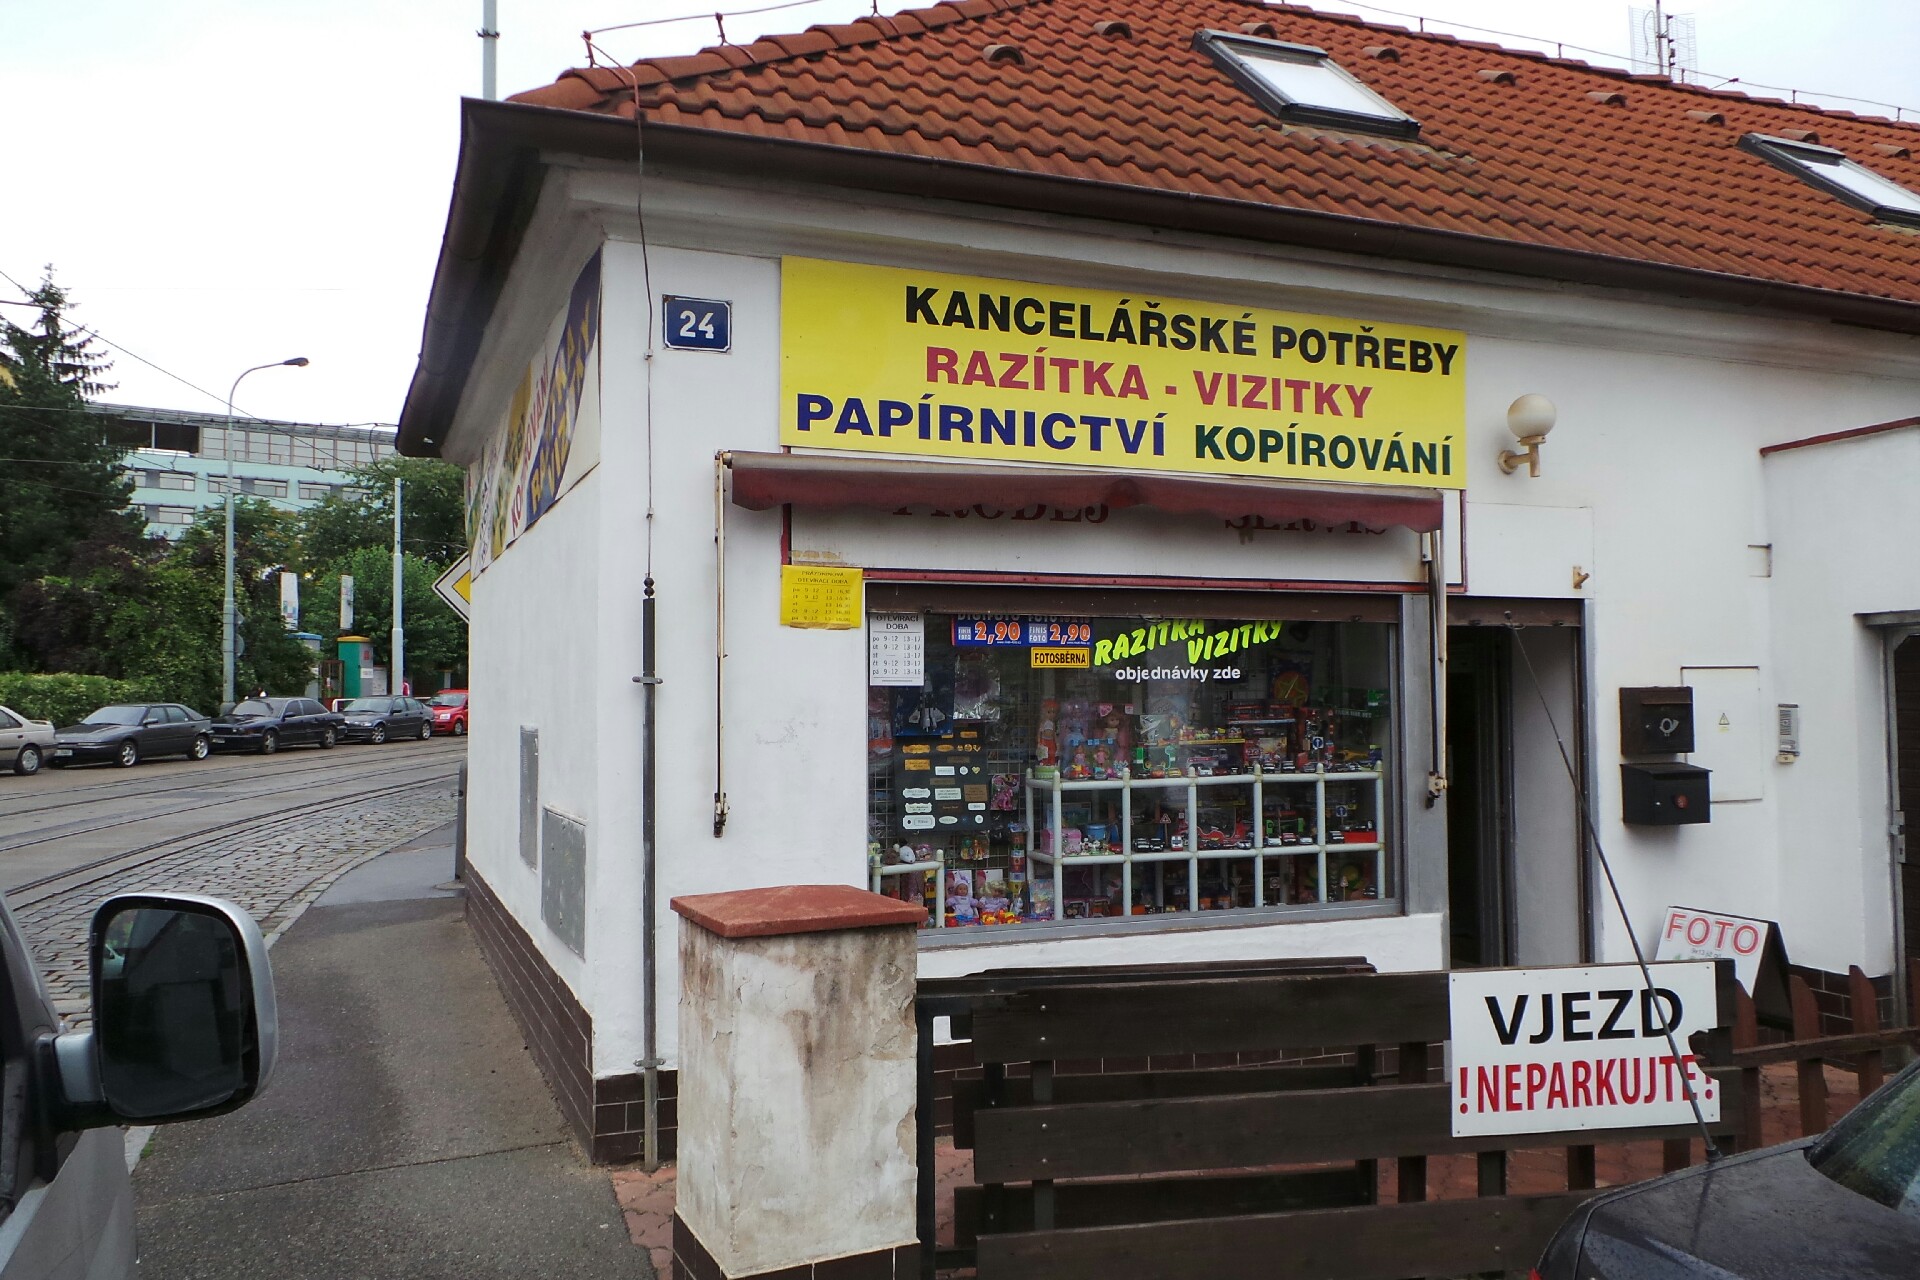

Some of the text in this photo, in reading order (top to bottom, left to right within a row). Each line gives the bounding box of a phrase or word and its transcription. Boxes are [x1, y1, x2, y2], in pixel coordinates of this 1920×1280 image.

[679, 310, 715, 340] 24
[904, 285, 1460, 376] KANCELÁŘSKÉ POTŘEBY
[926, 346, 1151, 401] RAZÍTKA
[1192, 370, 1374, 419] VIZITKY
[796, 393, 1452, 477] PAPÍRNICTVÍ KOPÍROVÁNÍ
[974, 620, 1021, 645] 2,90
[1029, 634, 1046, 642] FOTO
[1049, 623, 1091, 645] 2,90
[1115, 665, 1241, 683] objednávky zde
[1665, 912, 1761, 956] FOTO
[1484, 986, 1684, 1046] VJEZD
